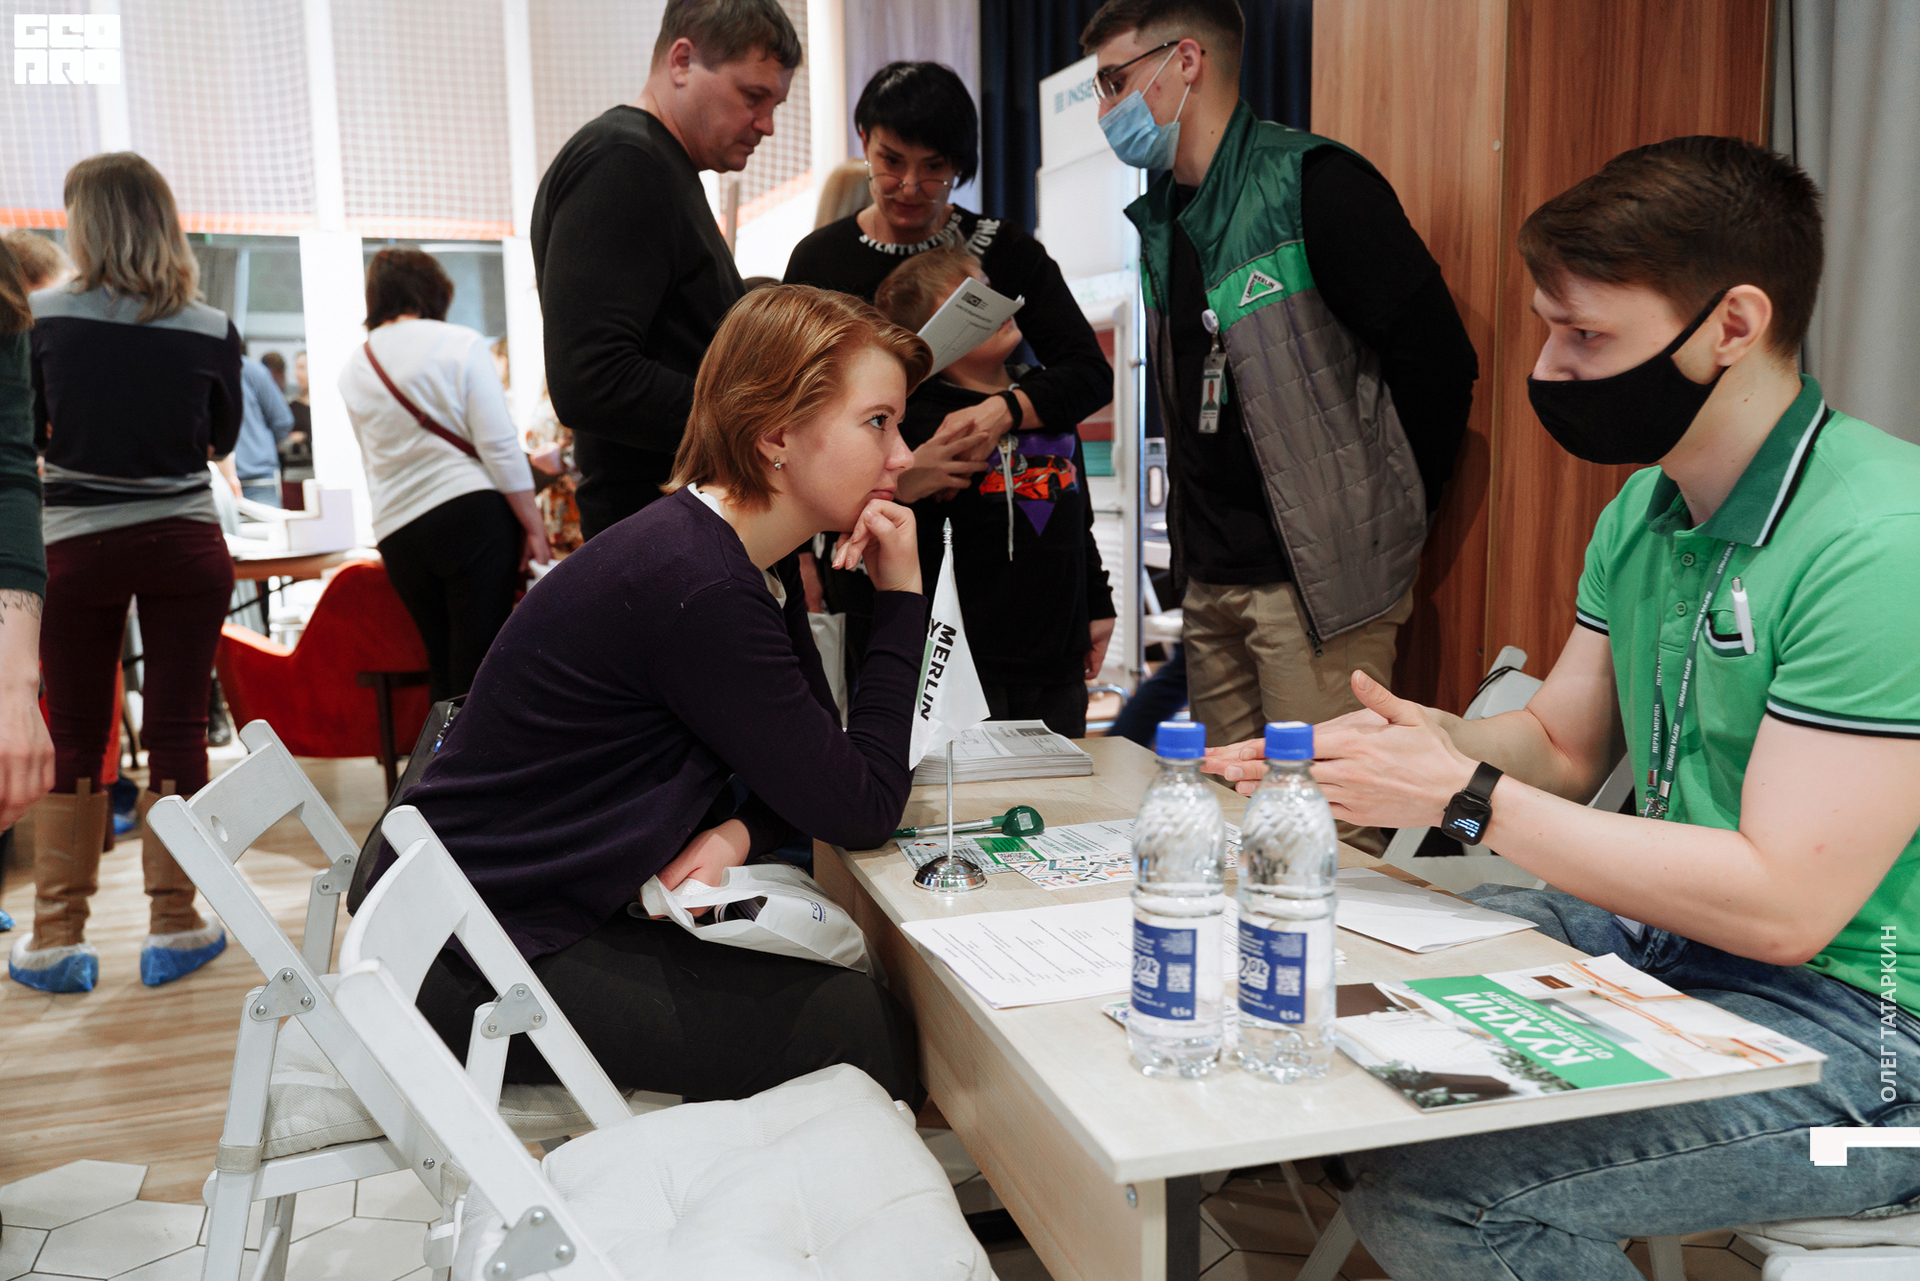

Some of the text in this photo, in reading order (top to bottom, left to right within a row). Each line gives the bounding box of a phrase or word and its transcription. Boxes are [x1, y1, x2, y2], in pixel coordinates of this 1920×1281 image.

[920, 623, 957, 721] MERLIN
[1678, 658, 1693, 708] ЛЕРУА МЕРЛЕН
[1652, 703, 1660, 754] ЛЕРУА МЕРЛЕН
[1665, 723, 1681, 771] ЛЕРУА МЕРЛЕН
[1441, 992, 1595, 1067] КУХНИ
[1481, 991, 1545, 1021] МЕРЛЕН
[1538, 1019, 1593, 1051] ЛЕРУА
[1586, 1047, 1614, 1060] ОТ
